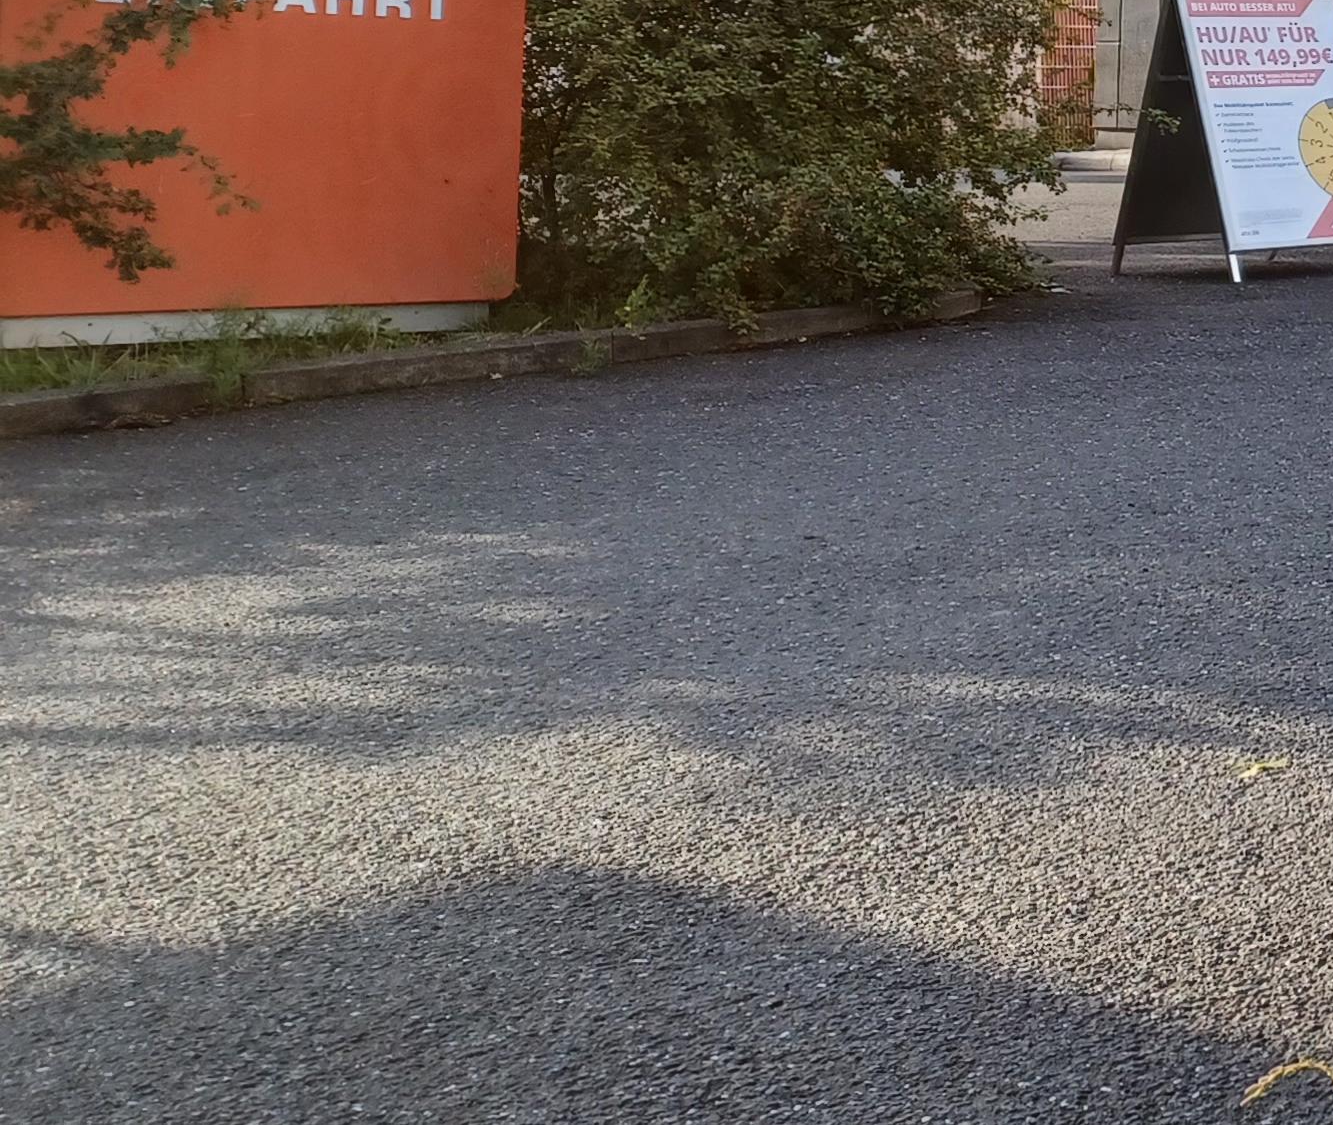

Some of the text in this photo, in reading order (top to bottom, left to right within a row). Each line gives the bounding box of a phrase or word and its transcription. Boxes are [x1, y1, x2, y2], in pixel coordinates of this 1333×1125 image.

[1191, 2, 1296, 12] BEI AUTO BESSER ATU
[1277, 22, 1320, 43] FÜR
[1201, 47, 1333, 68] NUR 149,99€
[1222, 74, 1266, 85] GRATIS
